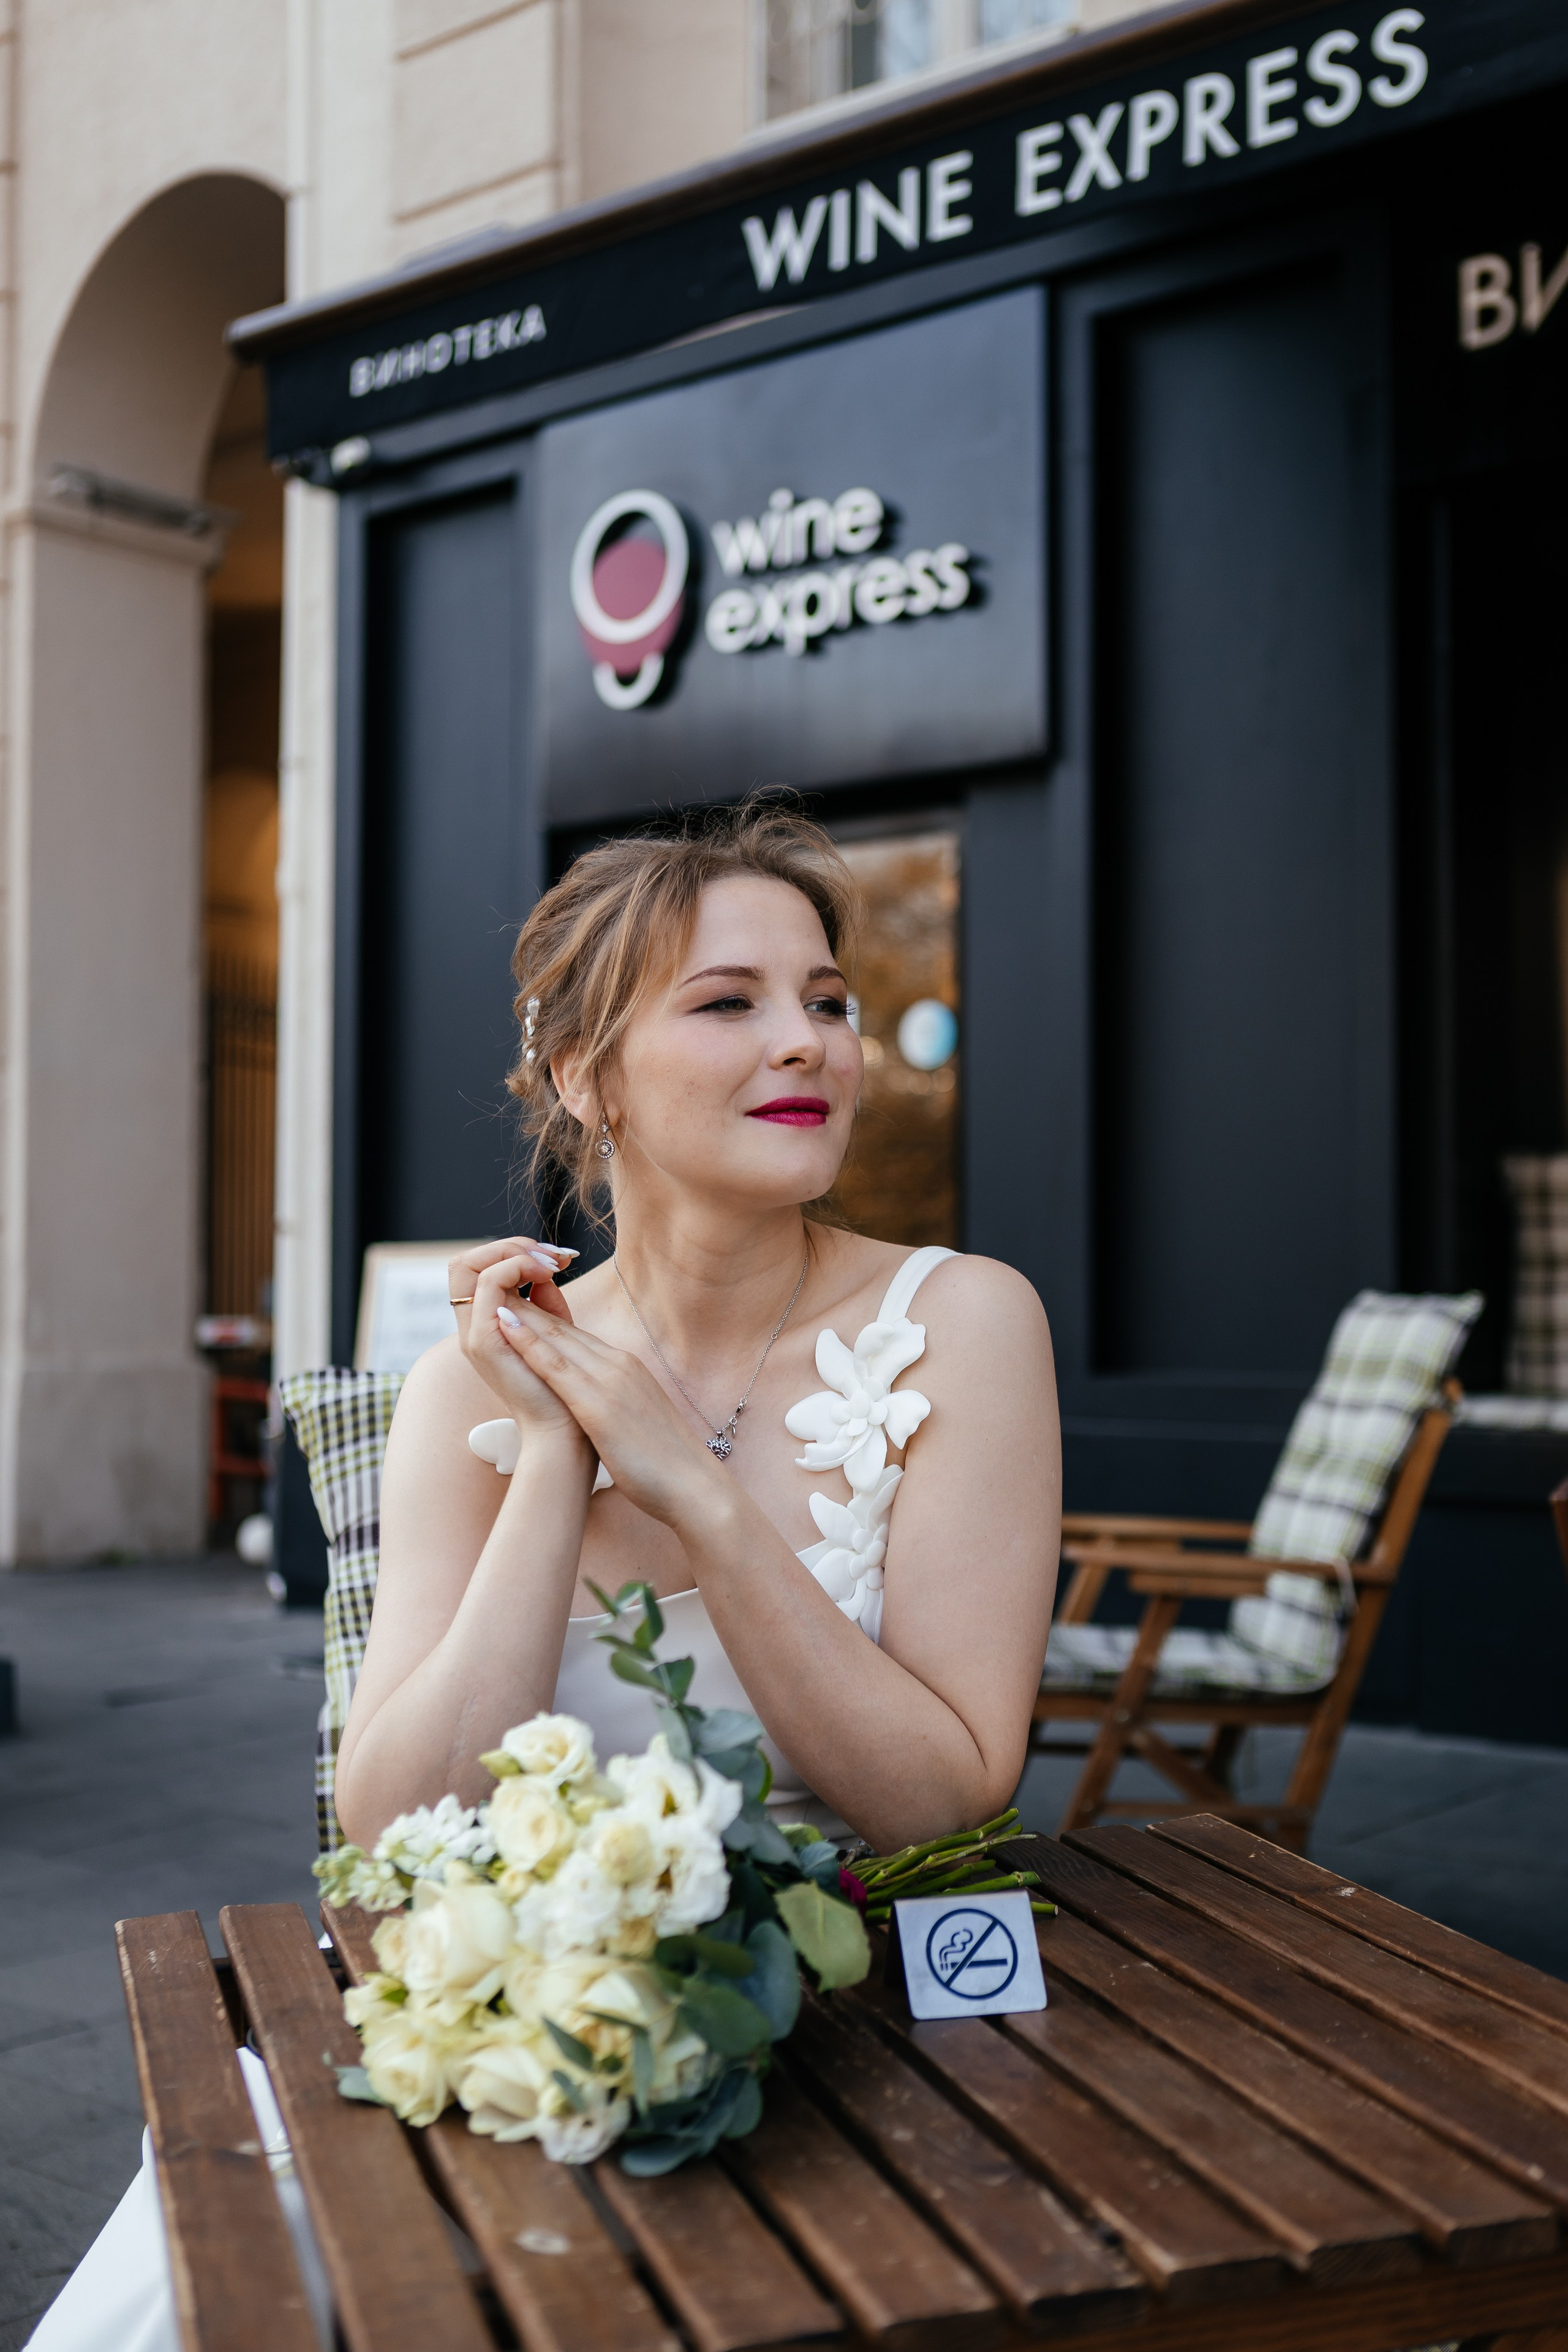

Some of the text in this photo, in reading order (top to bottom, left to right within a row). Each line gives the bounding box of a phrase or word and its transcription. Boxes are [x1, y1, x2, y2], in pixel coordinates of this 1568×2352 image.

[741, 7, 1430, 292] WINE EXPRESS
[349, 304, 546, 398] ВИНОТЕКА
[710, 487, 884, 578] wine
[704, 542, 971, 658] express
